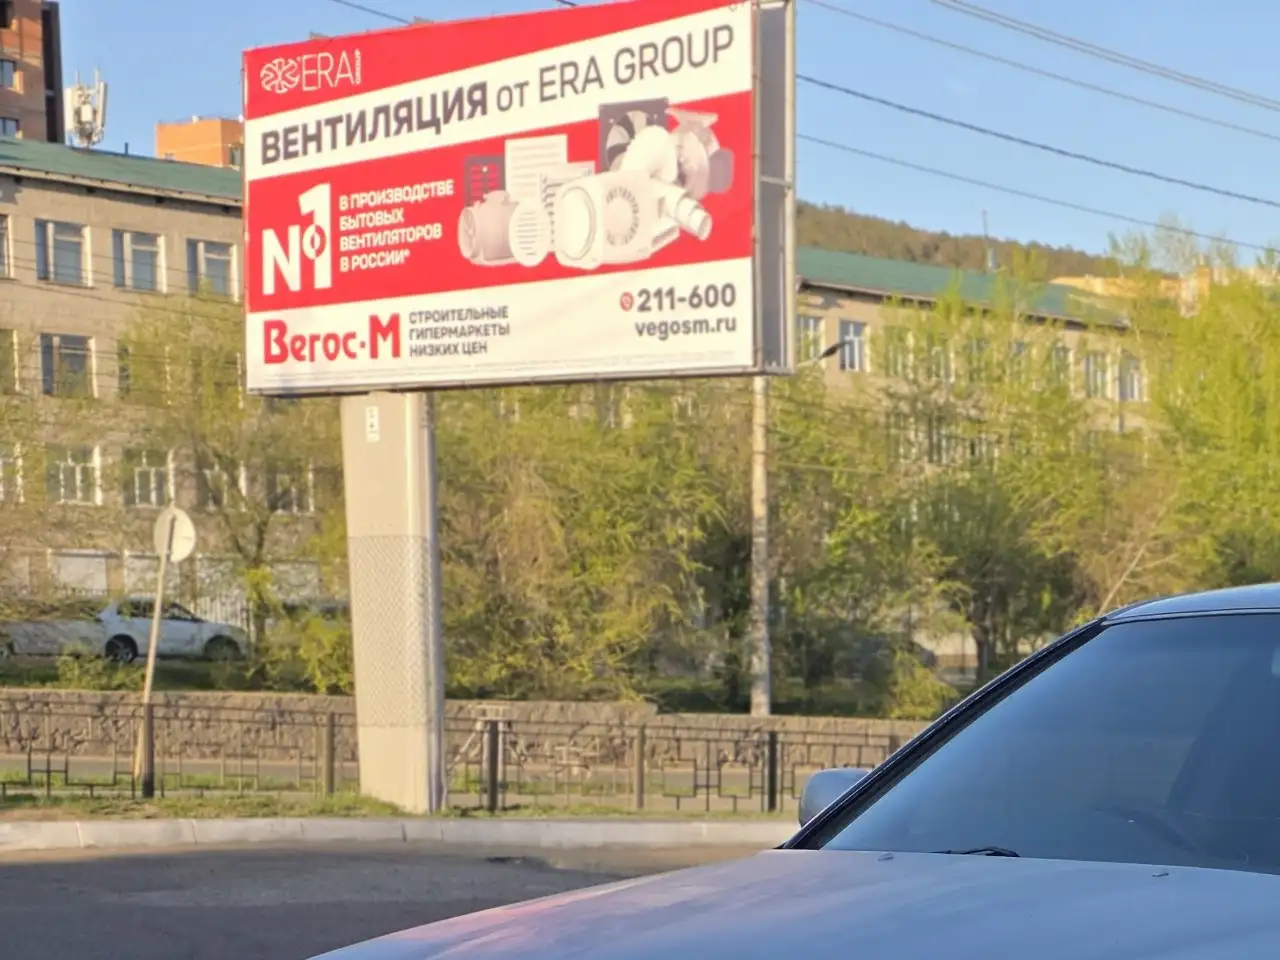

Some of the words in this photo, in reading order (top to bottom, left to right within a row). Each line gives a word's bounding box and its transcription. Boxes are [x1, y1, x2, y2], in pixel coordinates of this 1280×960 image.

[301, 50, 355, 91] ERA
[260, 81, 488, 165] ВЕНТИЛЯЦИЯ
[539, 55, 605, 103] ERA
[614, 24, 735, 85] GROUP
[339, 195, 349, 211] В
[350, 179, 455, 210] ПРОИЗВОДСТВЕ
[339, 207, 405, 231] БЫТОВЫХ
[339, 222, 443, 252] ВЕНТИЛЯТОРОВ
[339, 256, 349, 272] В
[636, 282, 737, 313] 211-600
[408, 305, 509, 325] СТРОИТЕЛЬНЫЕ
[408, 322, 510, 341] ГИПЕРМАРКЕТЫ
[634, 317, 737, 341] vegosm.ru
[408, 341, 459, 358] НИЗКИХ
[461, 341, 488, 356] ЦЕН
